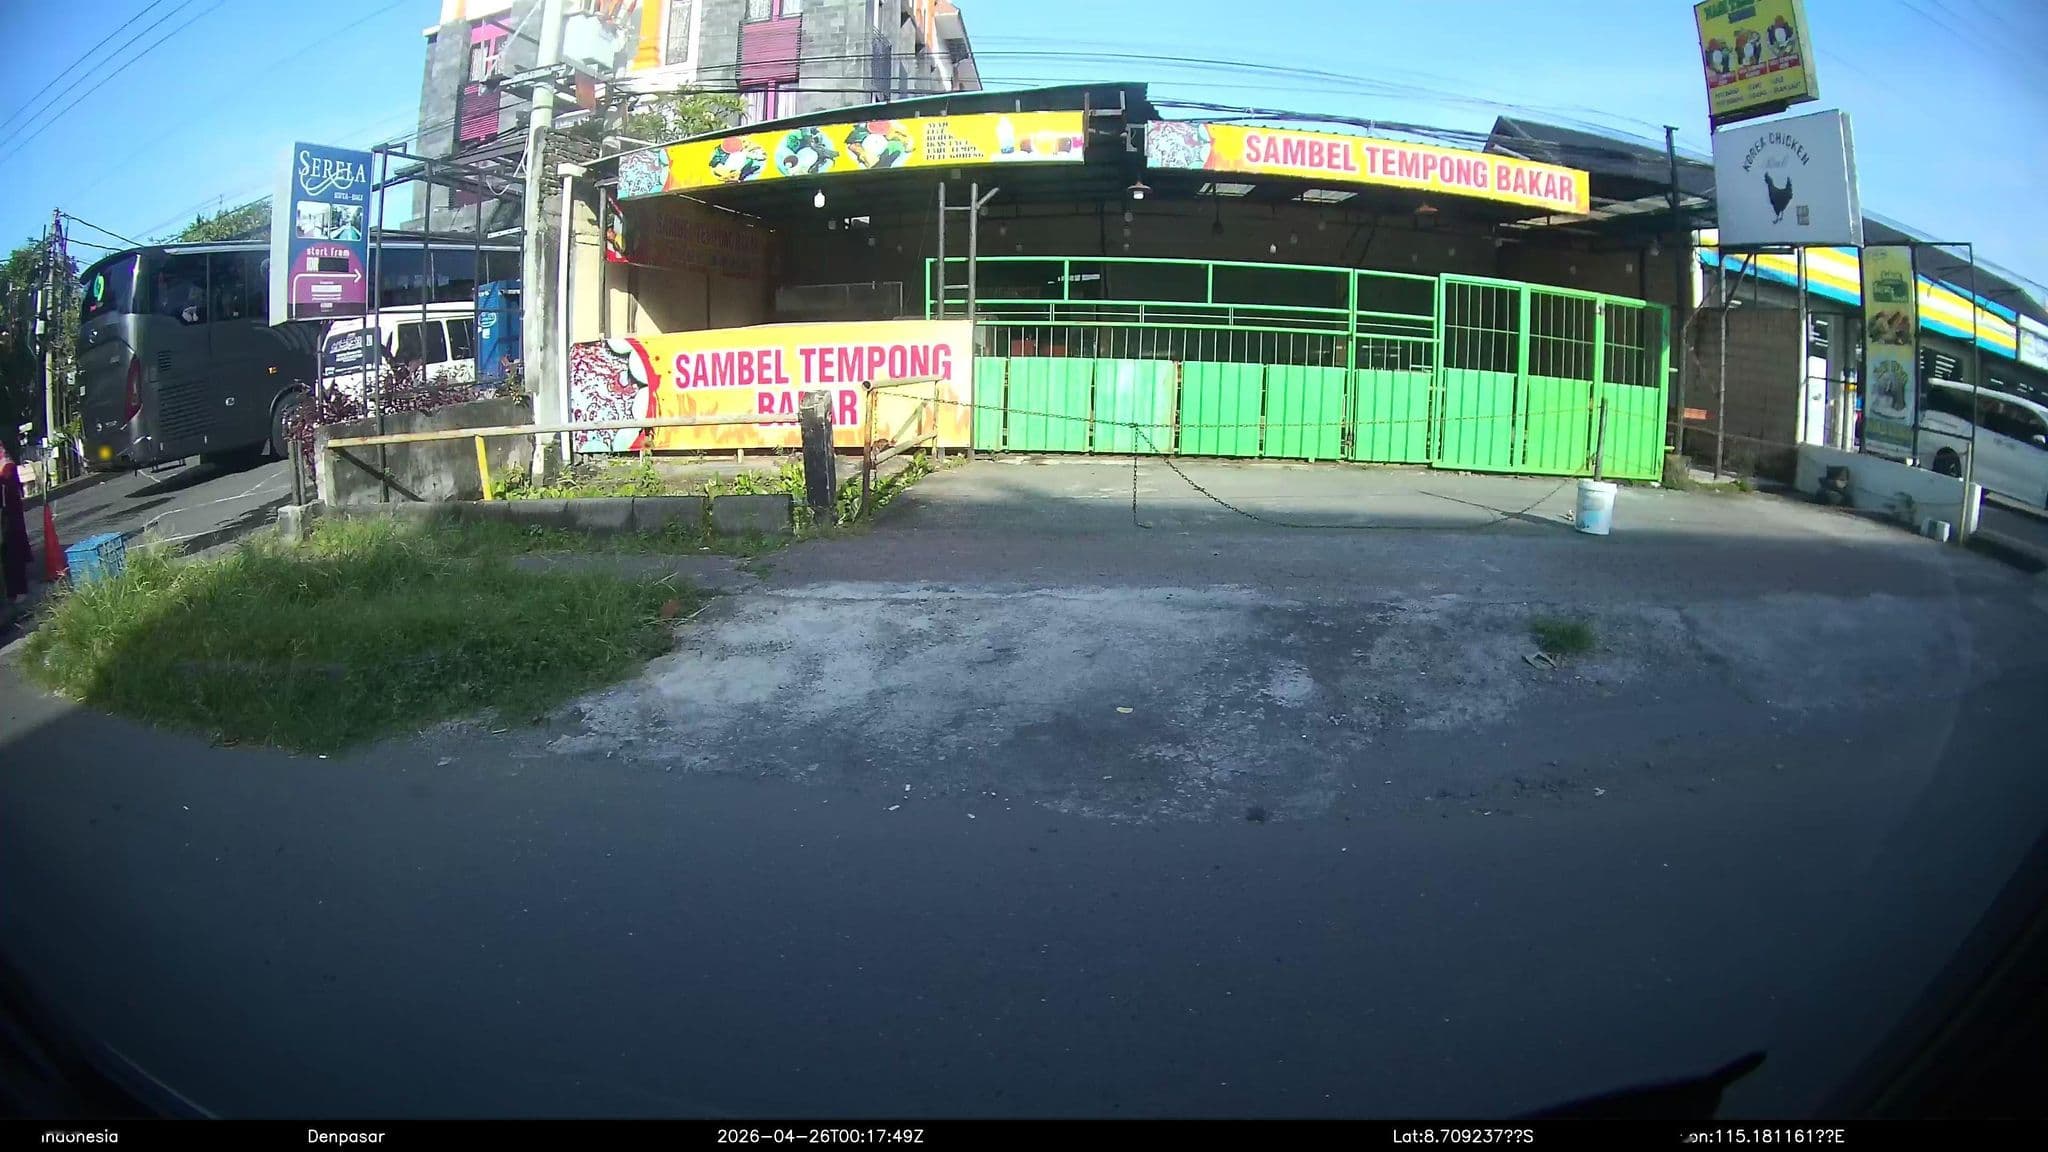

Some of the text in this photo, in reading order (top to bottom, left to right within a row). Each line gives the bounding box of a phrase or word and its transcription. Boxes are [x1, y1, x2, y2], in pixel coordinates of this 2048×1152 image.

[298, 150, 367, 184] SERELA
[1245, 135, 1575, 201] SAMBEL TEMPONG BAKAR
[1768, 132, 1811, 167] CHICKEN
[674, 343, 952, 389] SAMBEL TEMPONG
[757, 389, 858, 427] BAR
